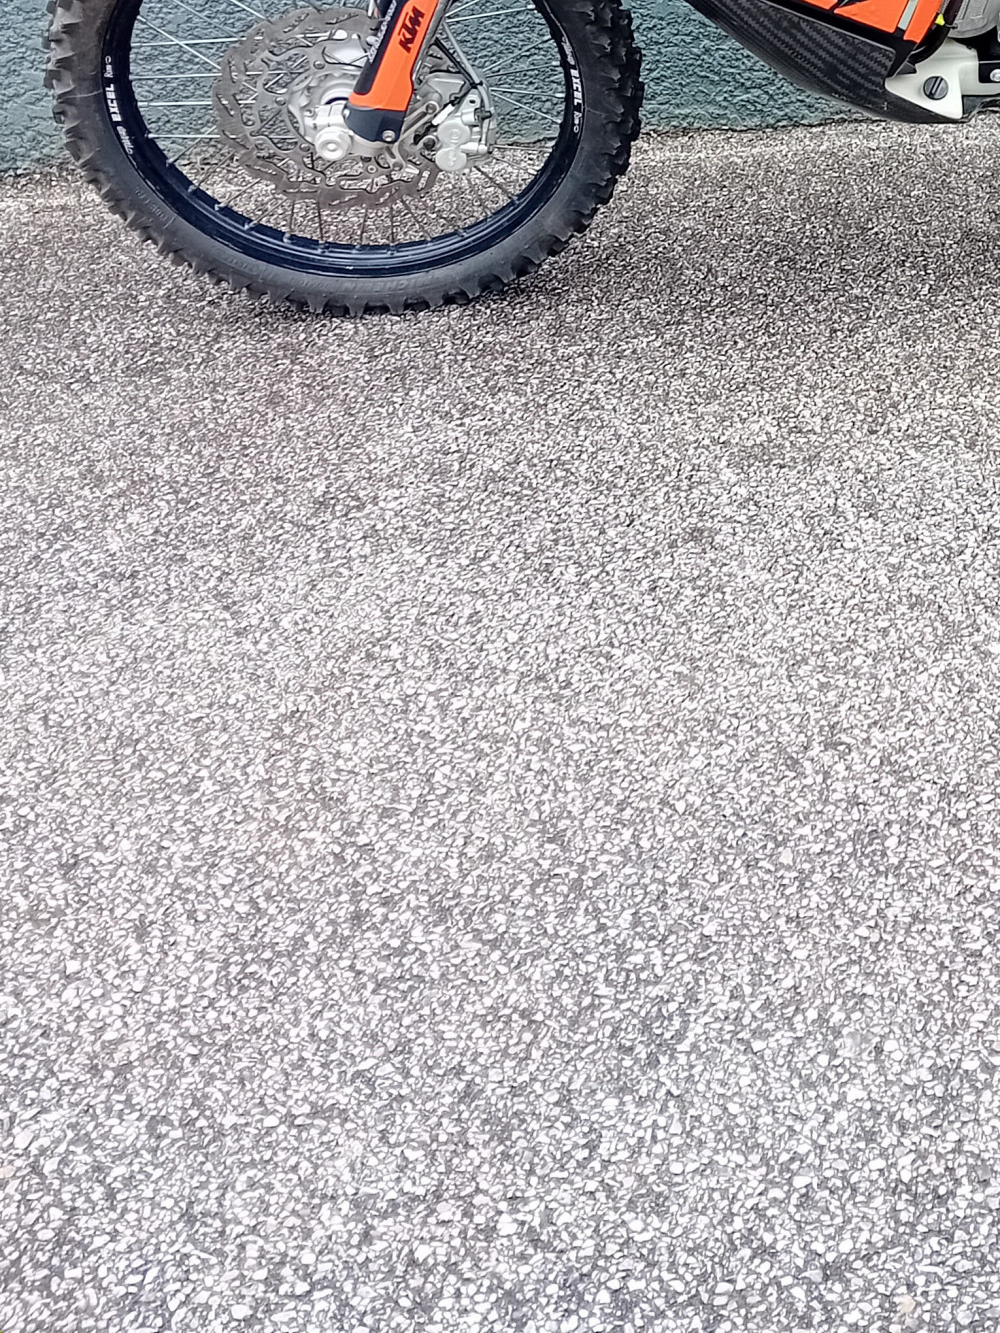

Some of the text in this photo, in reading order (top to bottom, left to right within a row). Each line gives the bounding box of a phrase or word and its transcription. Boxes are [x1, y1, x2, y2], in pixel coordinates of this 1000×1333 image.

[397, 5, 426, 55] KTM
[105, 83, 122, 122] EXCEL
[570, 68, 583, 106] EXCEL
